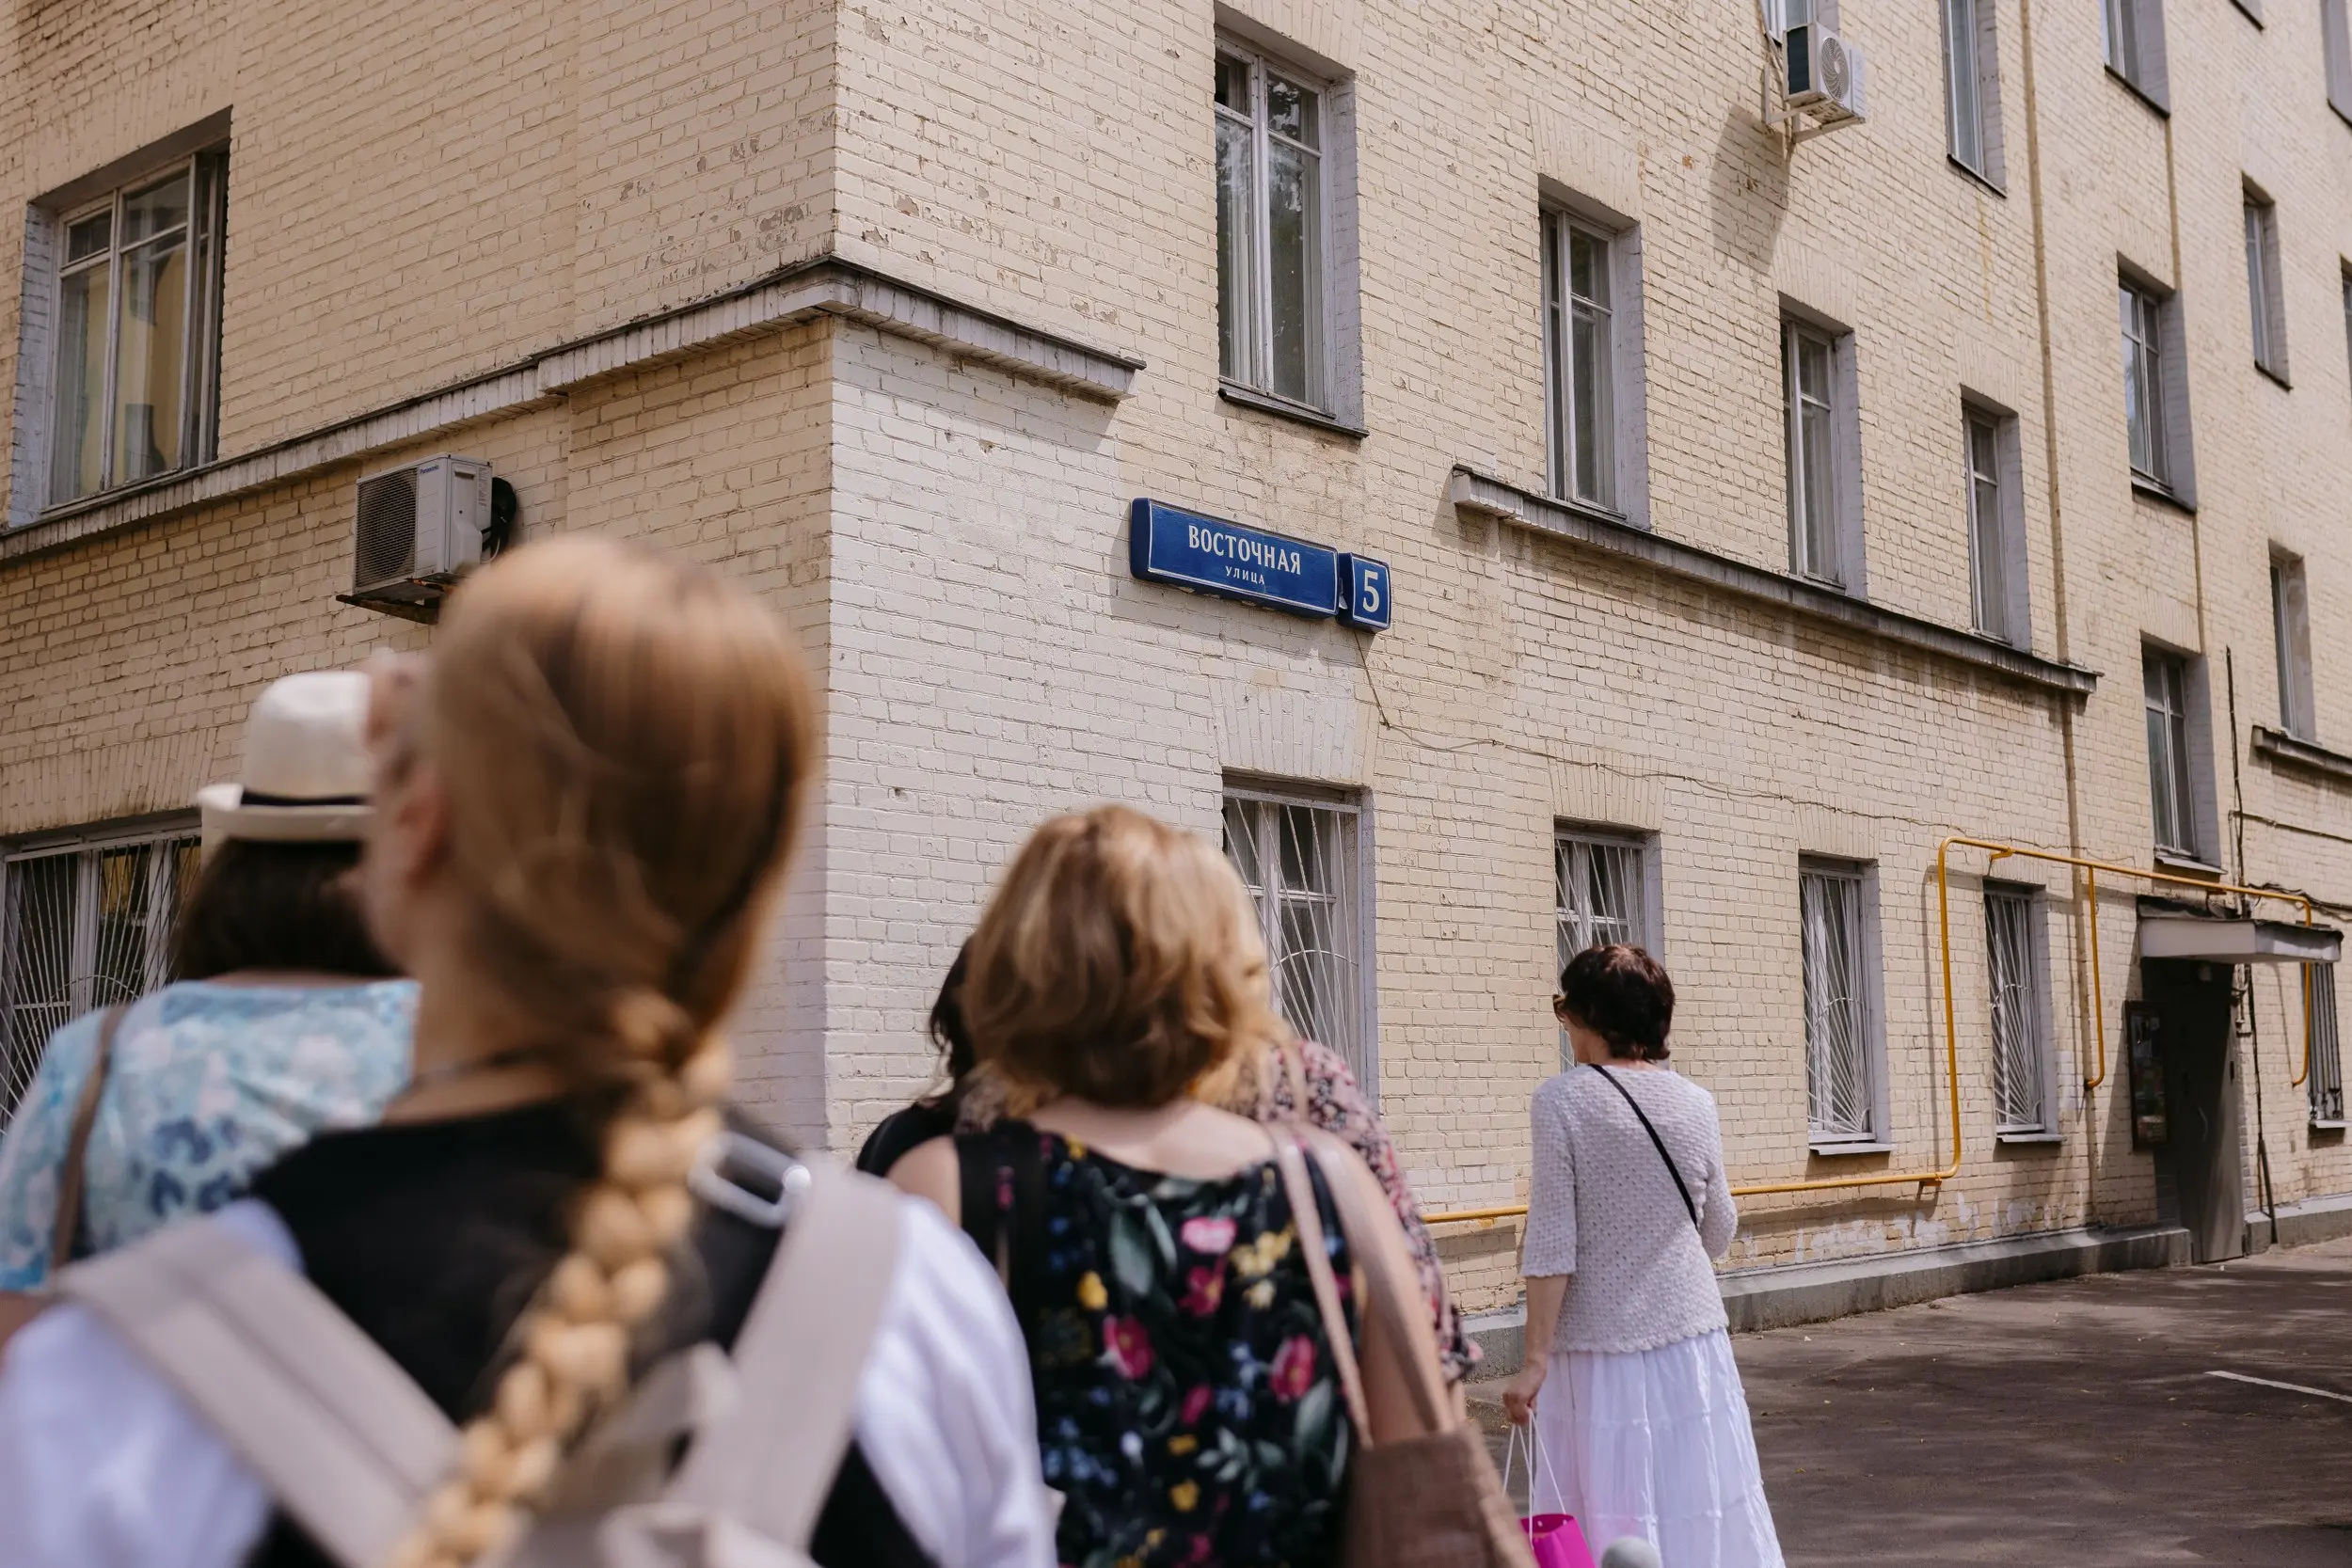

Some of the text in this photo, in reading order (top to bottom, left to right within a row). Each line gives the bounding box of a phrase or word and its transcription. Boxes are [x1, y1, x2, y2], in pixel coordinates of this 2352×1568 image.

[1188, 525, 1301, 576] ВОСТОЧНАЯ
[1225, 565, 1264, 585] УЛИЦА
[1362, 570, 1379, 612] 5
